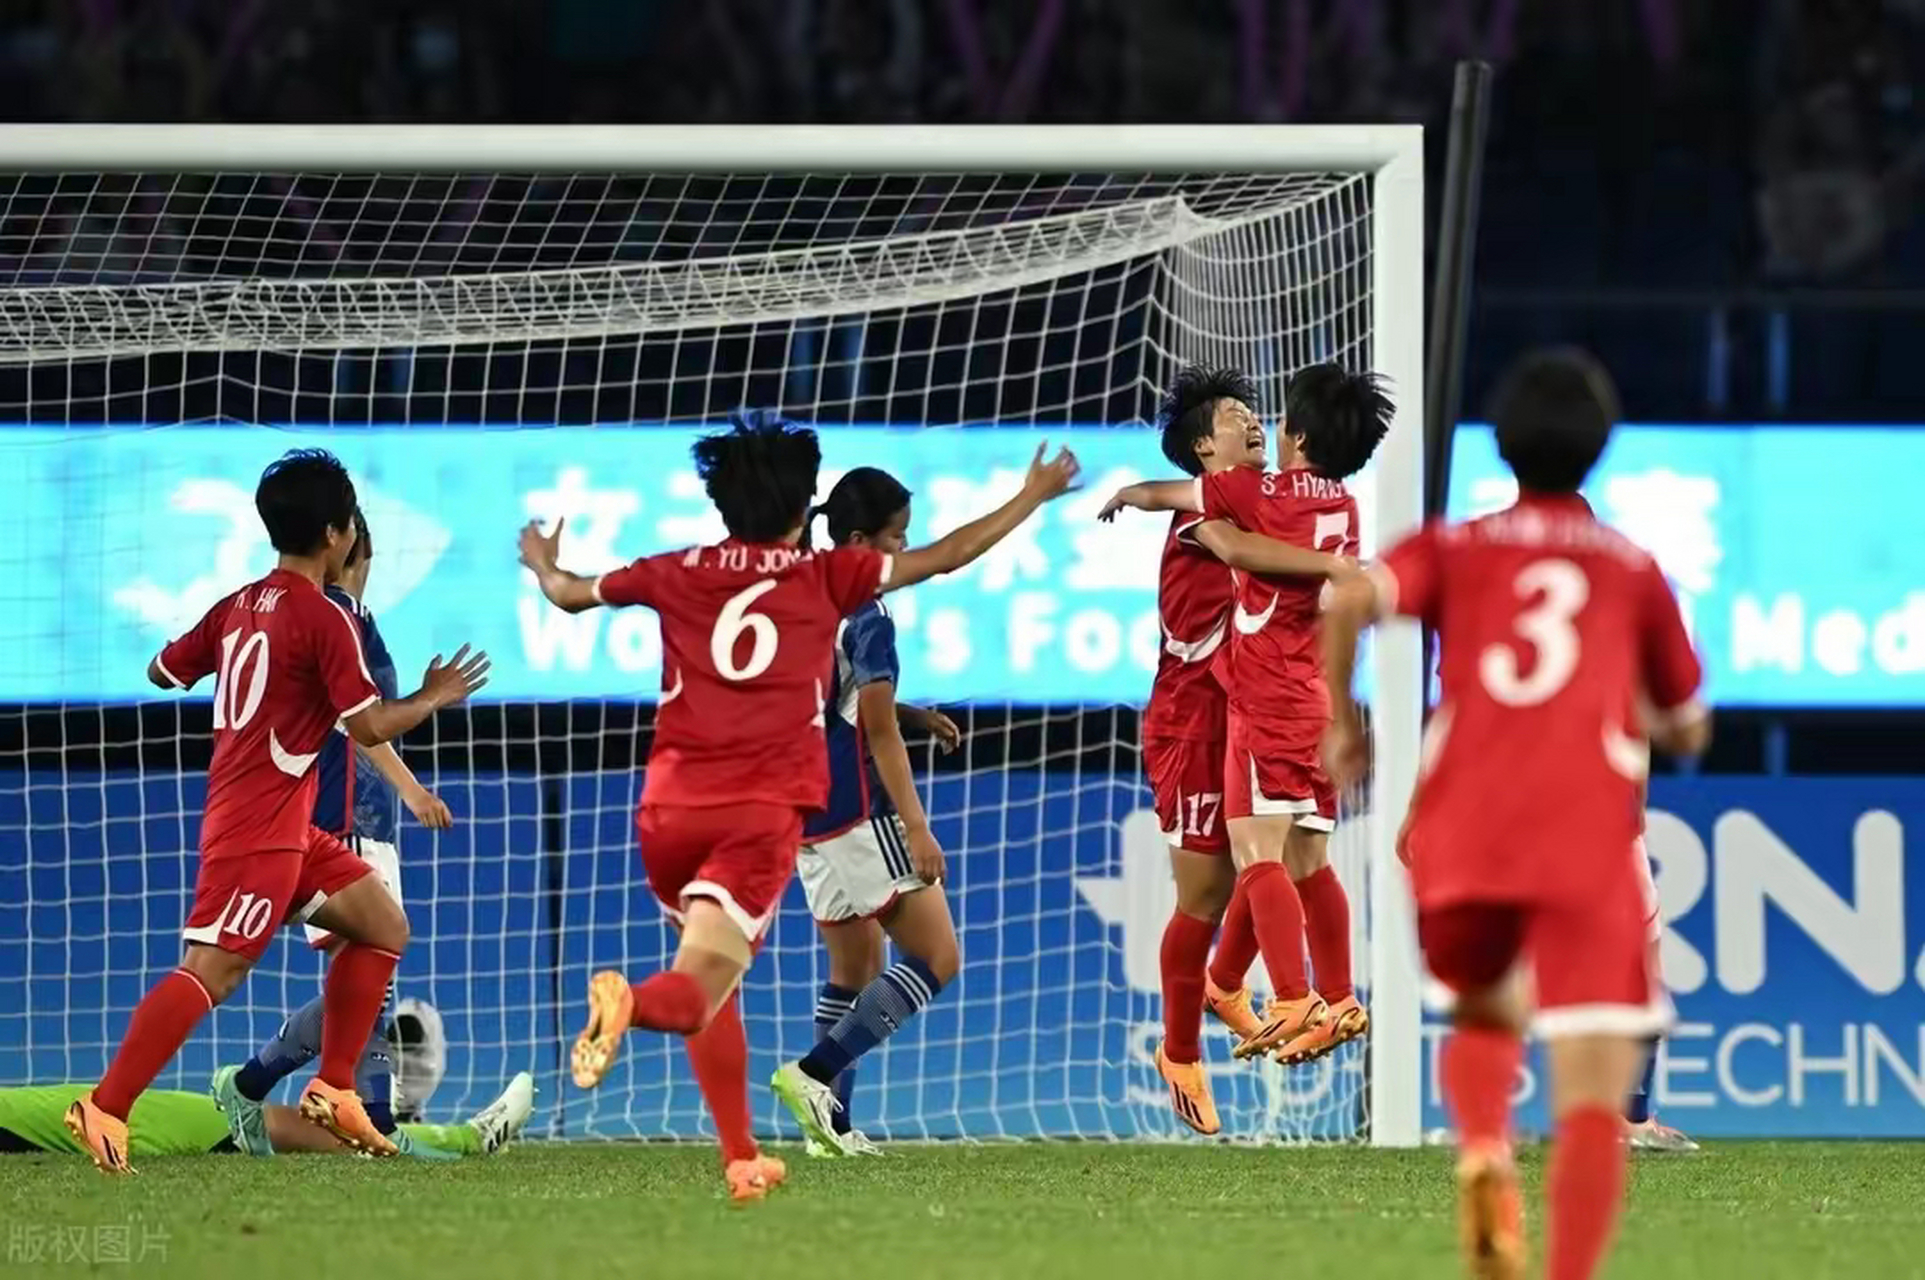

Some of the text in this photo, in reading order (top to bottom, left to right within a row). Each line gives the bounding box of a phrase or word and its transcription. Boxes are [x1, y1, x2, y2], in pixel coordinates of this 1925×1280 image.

[719, 545, 747, 571] YU
[1314, 511, 1349, 557] 7
[710, 578, 778, 681] 6
[1478, 557, 1591, 708] 3
[213, 627, 269, 730] 10
[1184, 792, 1222, 837] 17
[223, 893, 273, 940] 10
[1655, 1022, 1925, 1108] ECHN
